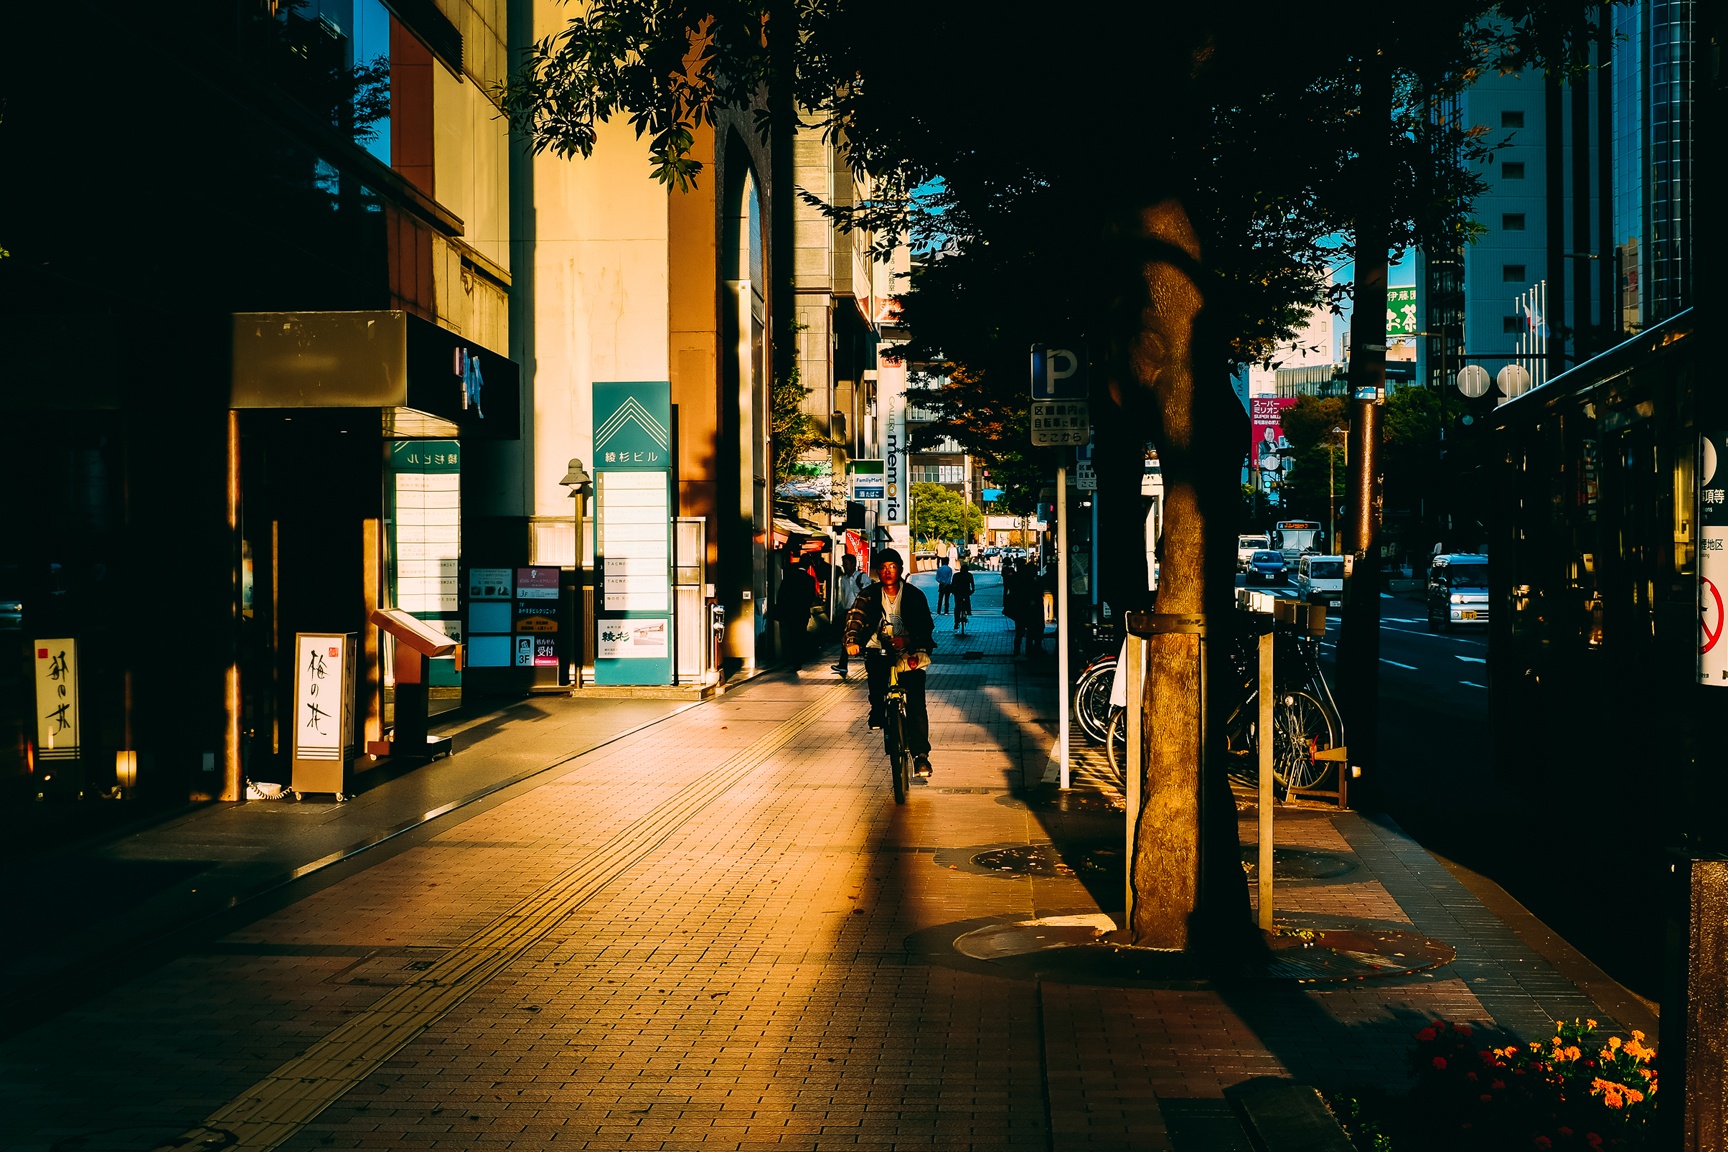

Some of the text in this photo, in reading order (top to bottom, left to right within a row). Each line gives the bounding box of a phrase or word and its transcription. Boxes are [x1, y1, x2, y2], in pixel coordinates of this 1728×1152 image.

[1046, 349, 1078, 394] P
[1034, 405, 1086, 416] 区画線内の
[1034, 417, 1086, 428] 自転車に限る
[1038, 432, 1082, 442] ここから
[605, 451, 658, 463] 綾杉ビル
[887, 434, 899, 521] memoria
[537, 646, 554, 657] 受付
[518, 655, 530, 664] 3F
[306, 649, 333, 736] 梅の花
